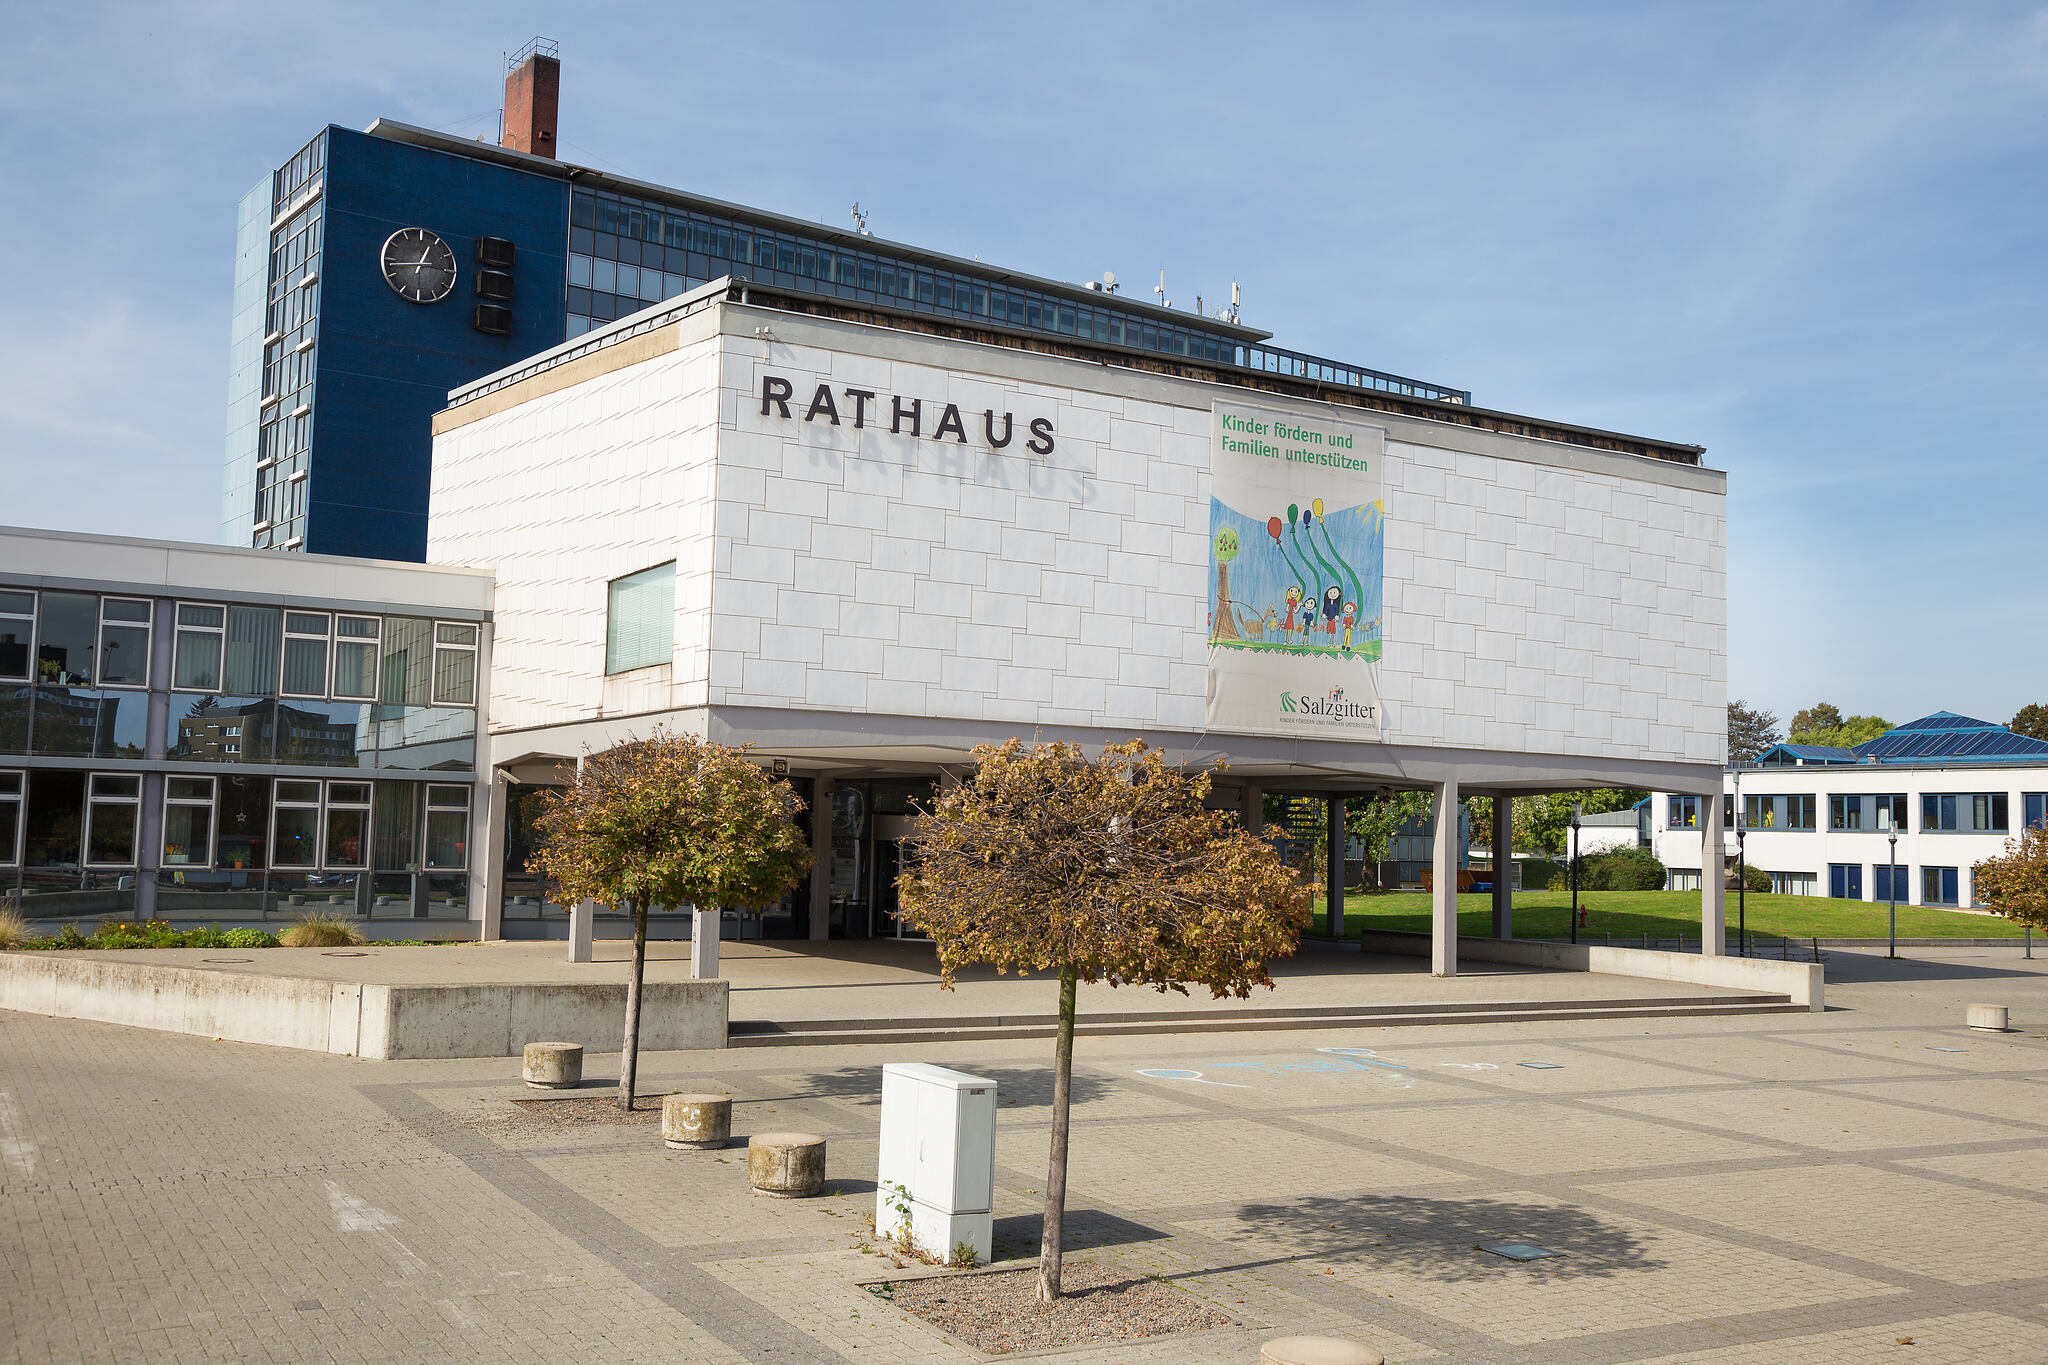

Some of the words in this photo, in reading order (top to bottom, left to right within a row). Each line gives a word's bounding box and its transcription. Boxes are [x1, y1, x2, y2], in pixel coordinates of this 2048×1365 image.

[760, 375, 1055, 455] RATHAUS
[1222, 414, 1269, 435] Kinder
[1273, 422, 1322, 444] fördern
[1328, 434, 1353, 449] und
[1222, 436, 1279, 458] Familien
[1285, 448, 1368, 472] unterstützen
[1300, 696, 1375, 721] Salzgitter
